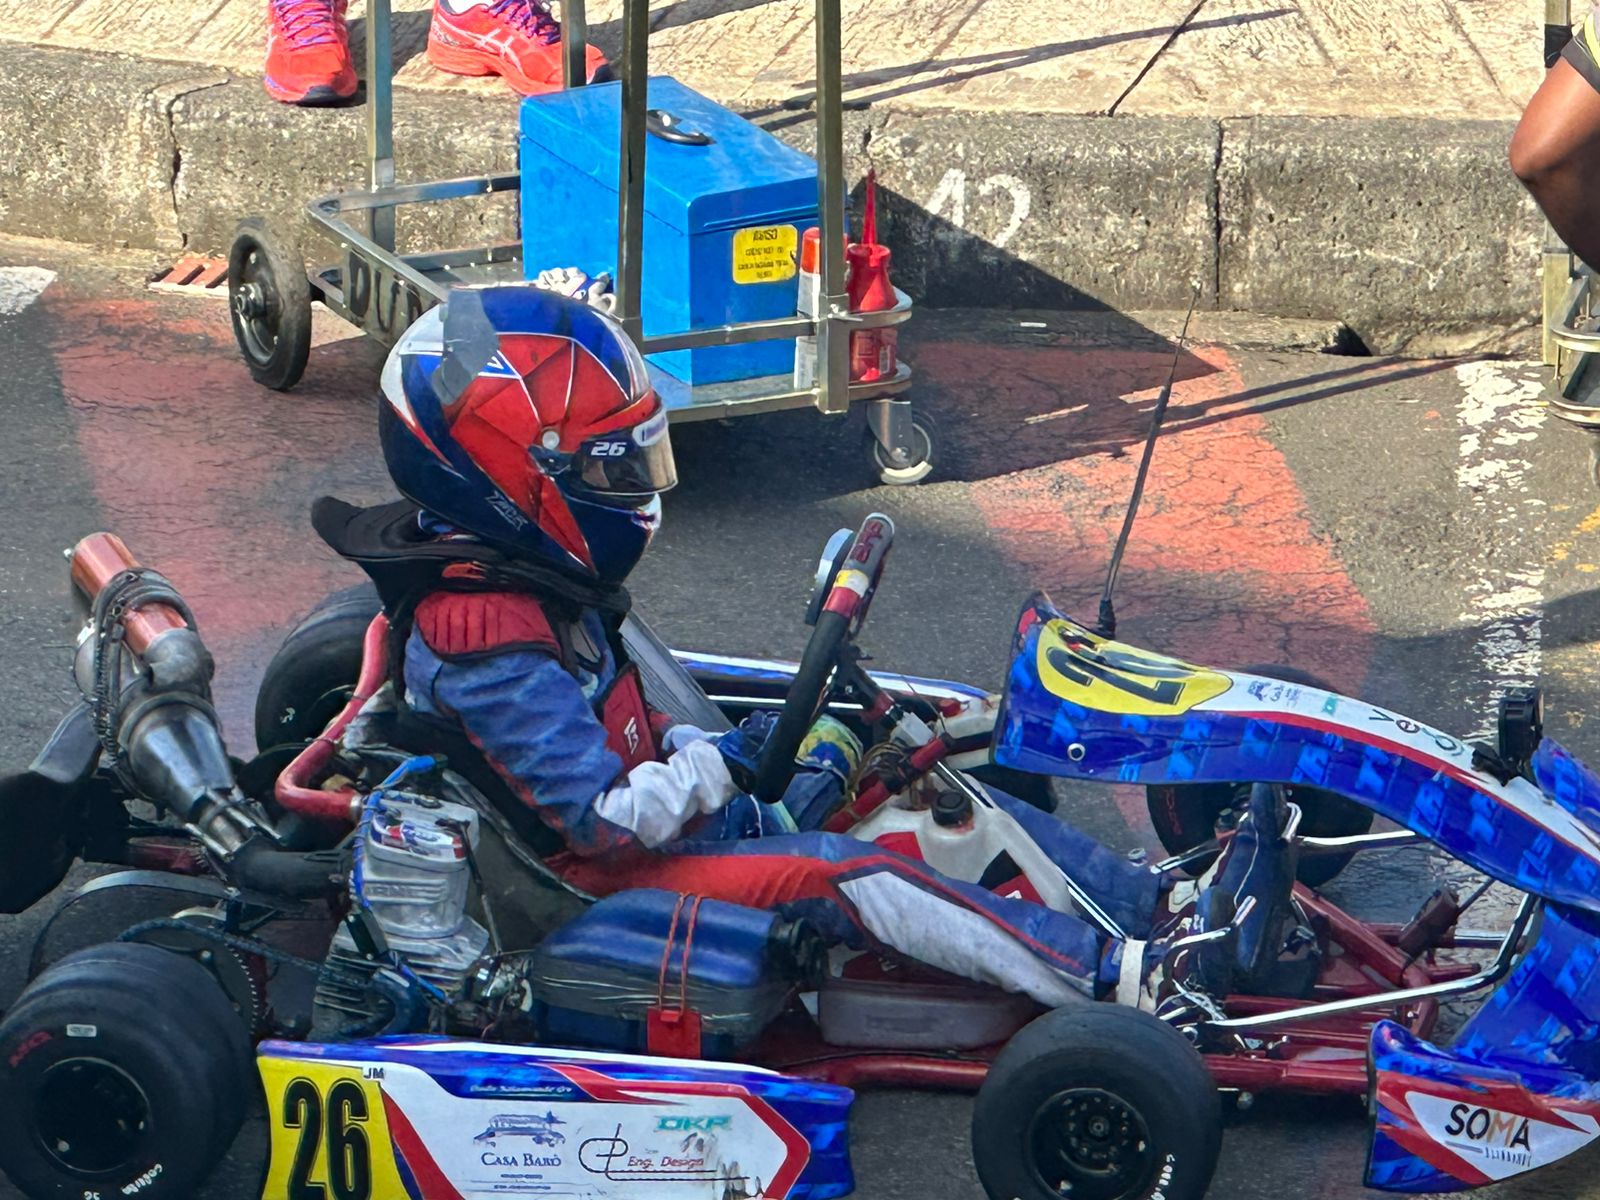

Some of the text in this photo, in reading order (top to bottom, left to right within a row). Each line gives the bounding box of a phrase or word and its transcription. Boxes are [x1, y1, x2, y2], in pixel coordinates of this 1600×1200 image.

[591, 442, 627, 457] 26
[363, 1068, 385, 1079] JM
[283, 1076, 372, 1200] 26
[1445, 1104, 1530, 1151] SOMA
